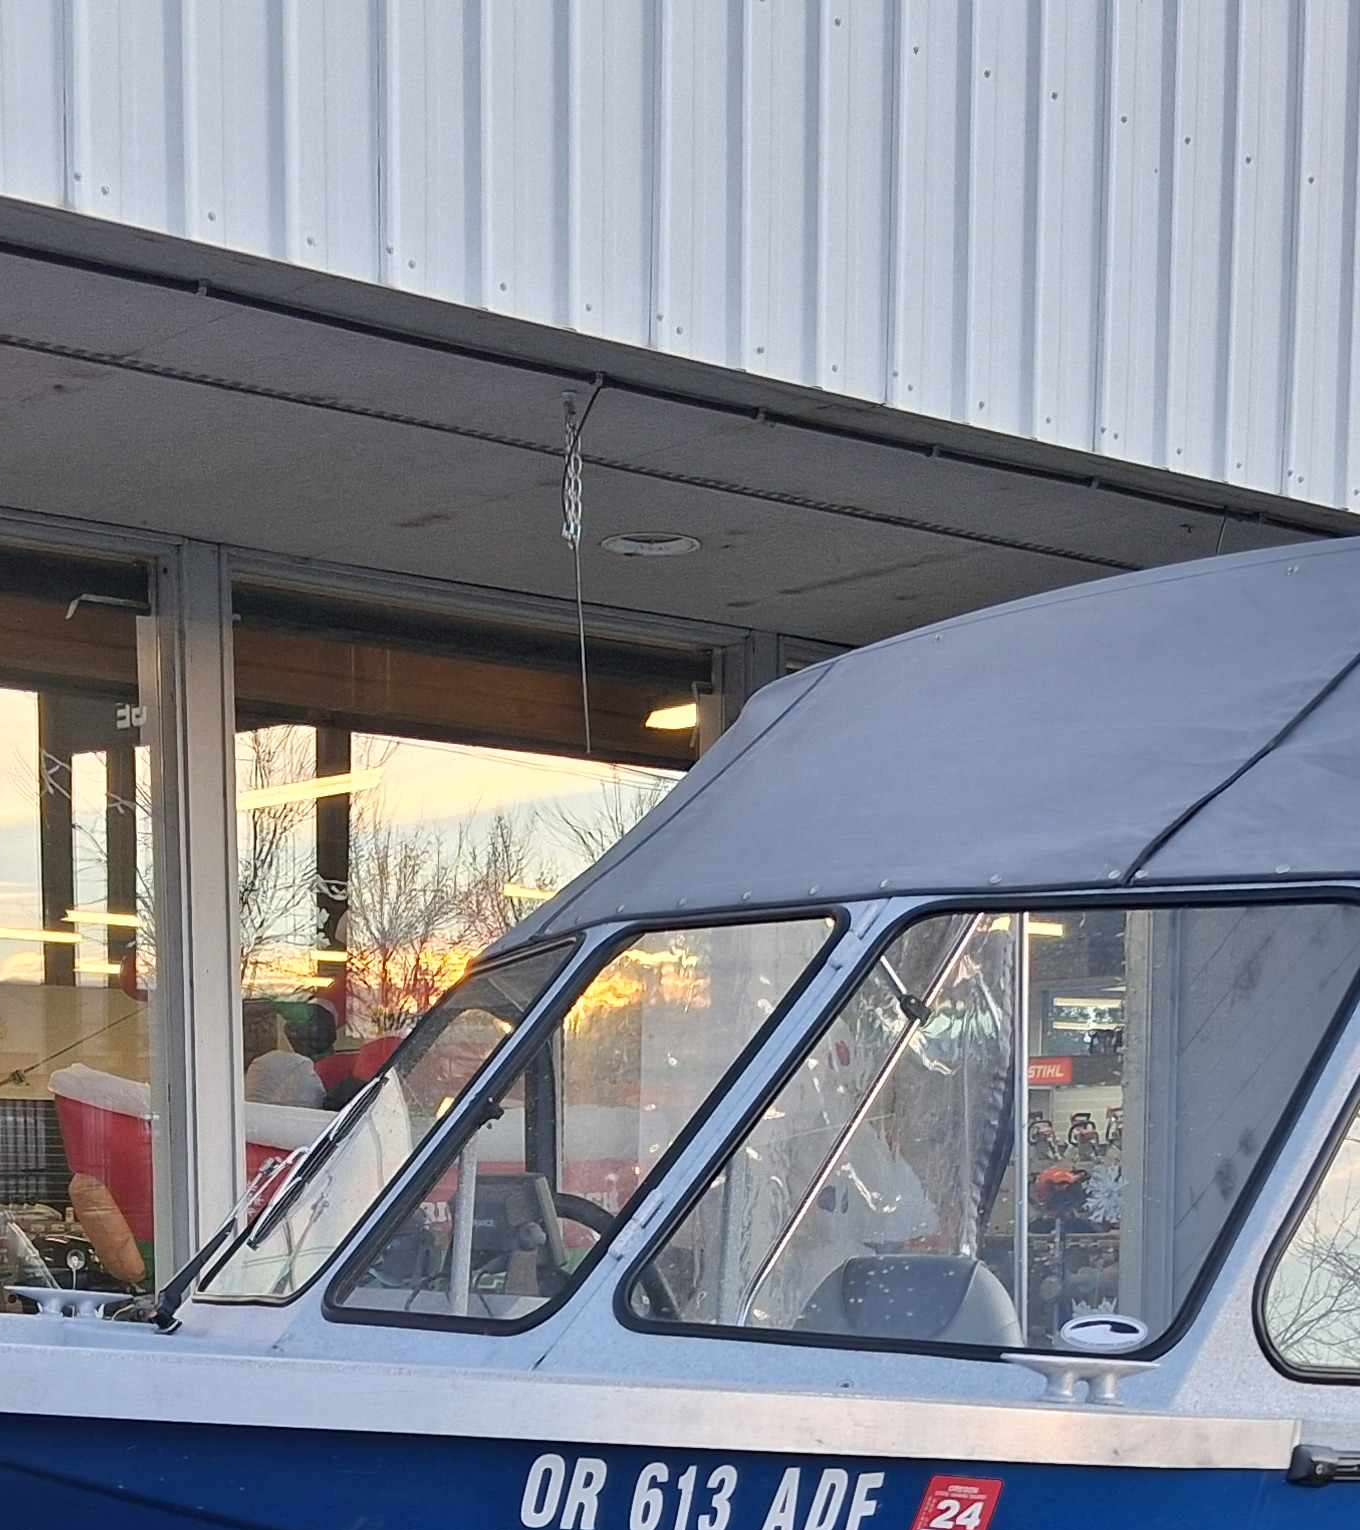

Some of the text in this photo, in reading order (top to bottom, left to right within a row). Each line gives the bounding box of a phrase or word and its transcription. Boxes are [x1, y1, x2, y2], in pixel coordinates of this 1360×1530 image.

[1028, 1063, 1064, 1079] STIHL
[520, 1453, 608, 1530] OR
[929, 1499, 985, 1530] 24
